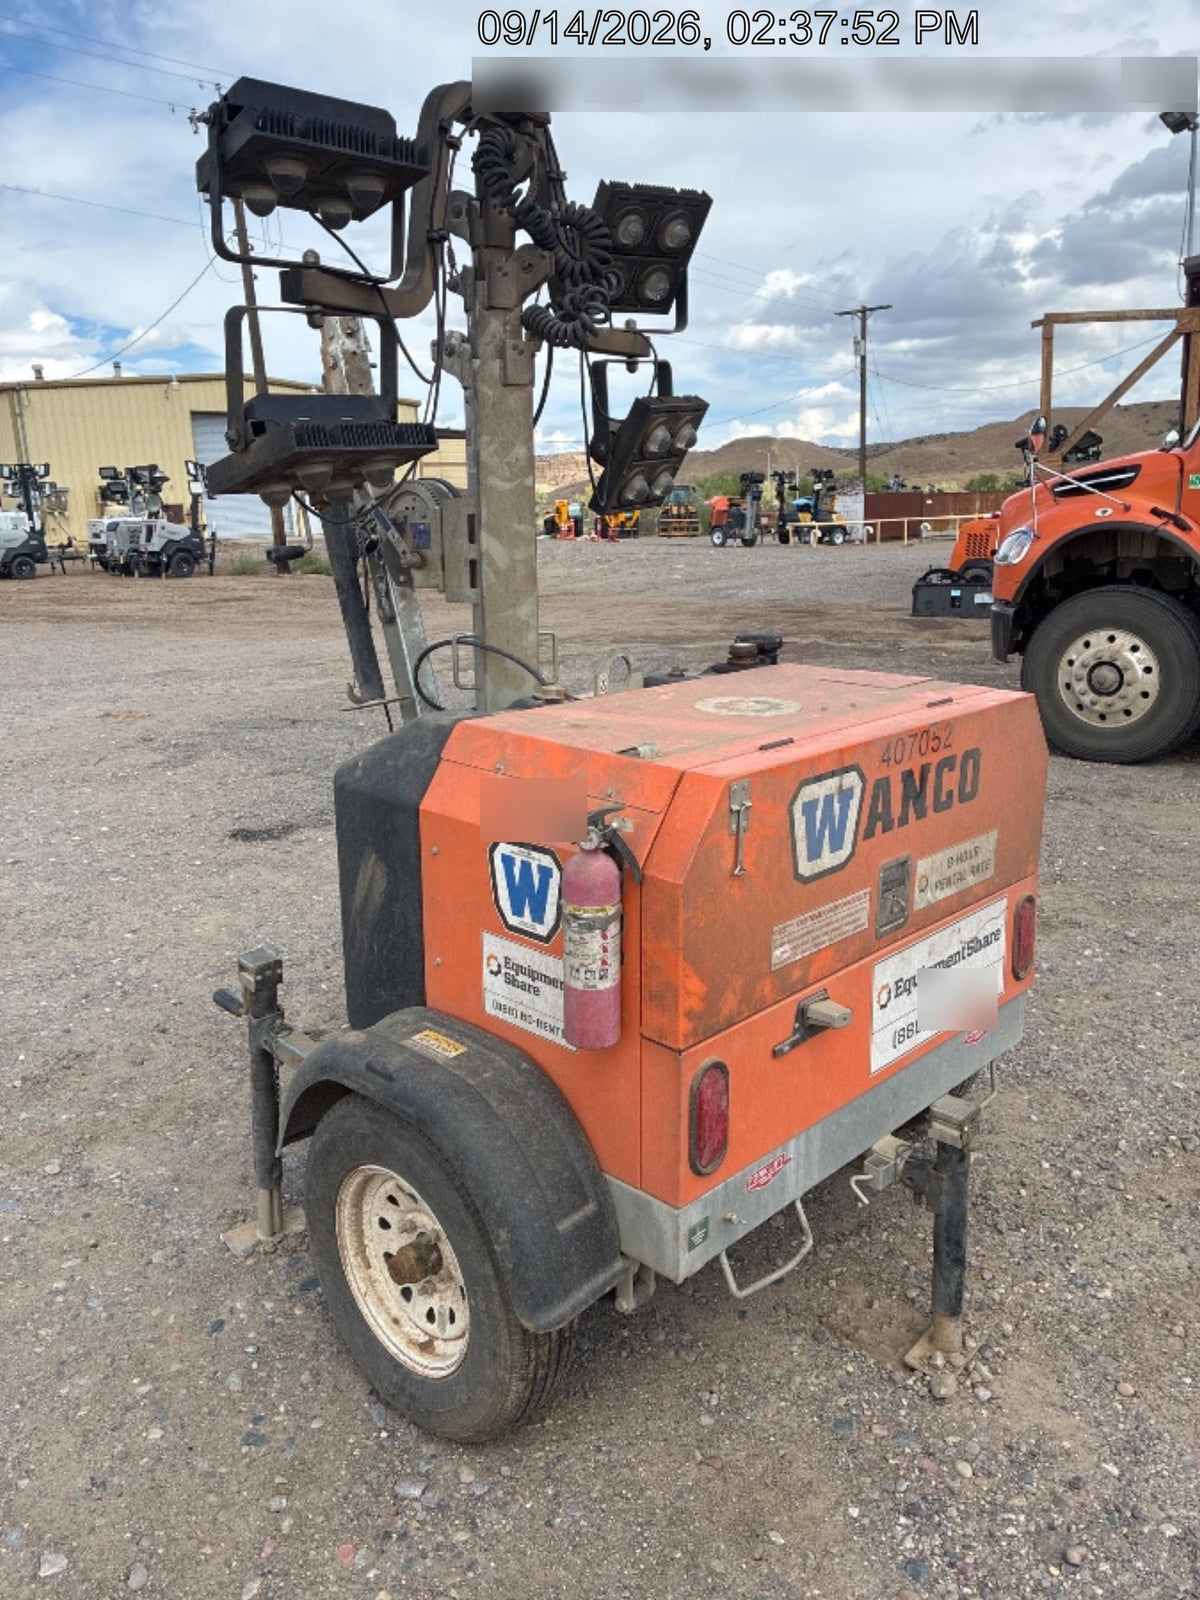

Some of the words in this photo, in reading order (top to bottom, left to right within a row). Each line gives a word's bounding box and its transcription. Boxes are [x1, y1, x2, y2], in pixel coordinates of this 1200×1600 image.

[881, 724, 954, 767] 407052
[501, 853, 553, 925] W
[503, 956, 565, 991] Equipmen
[504, 972, 541, 996] Share
